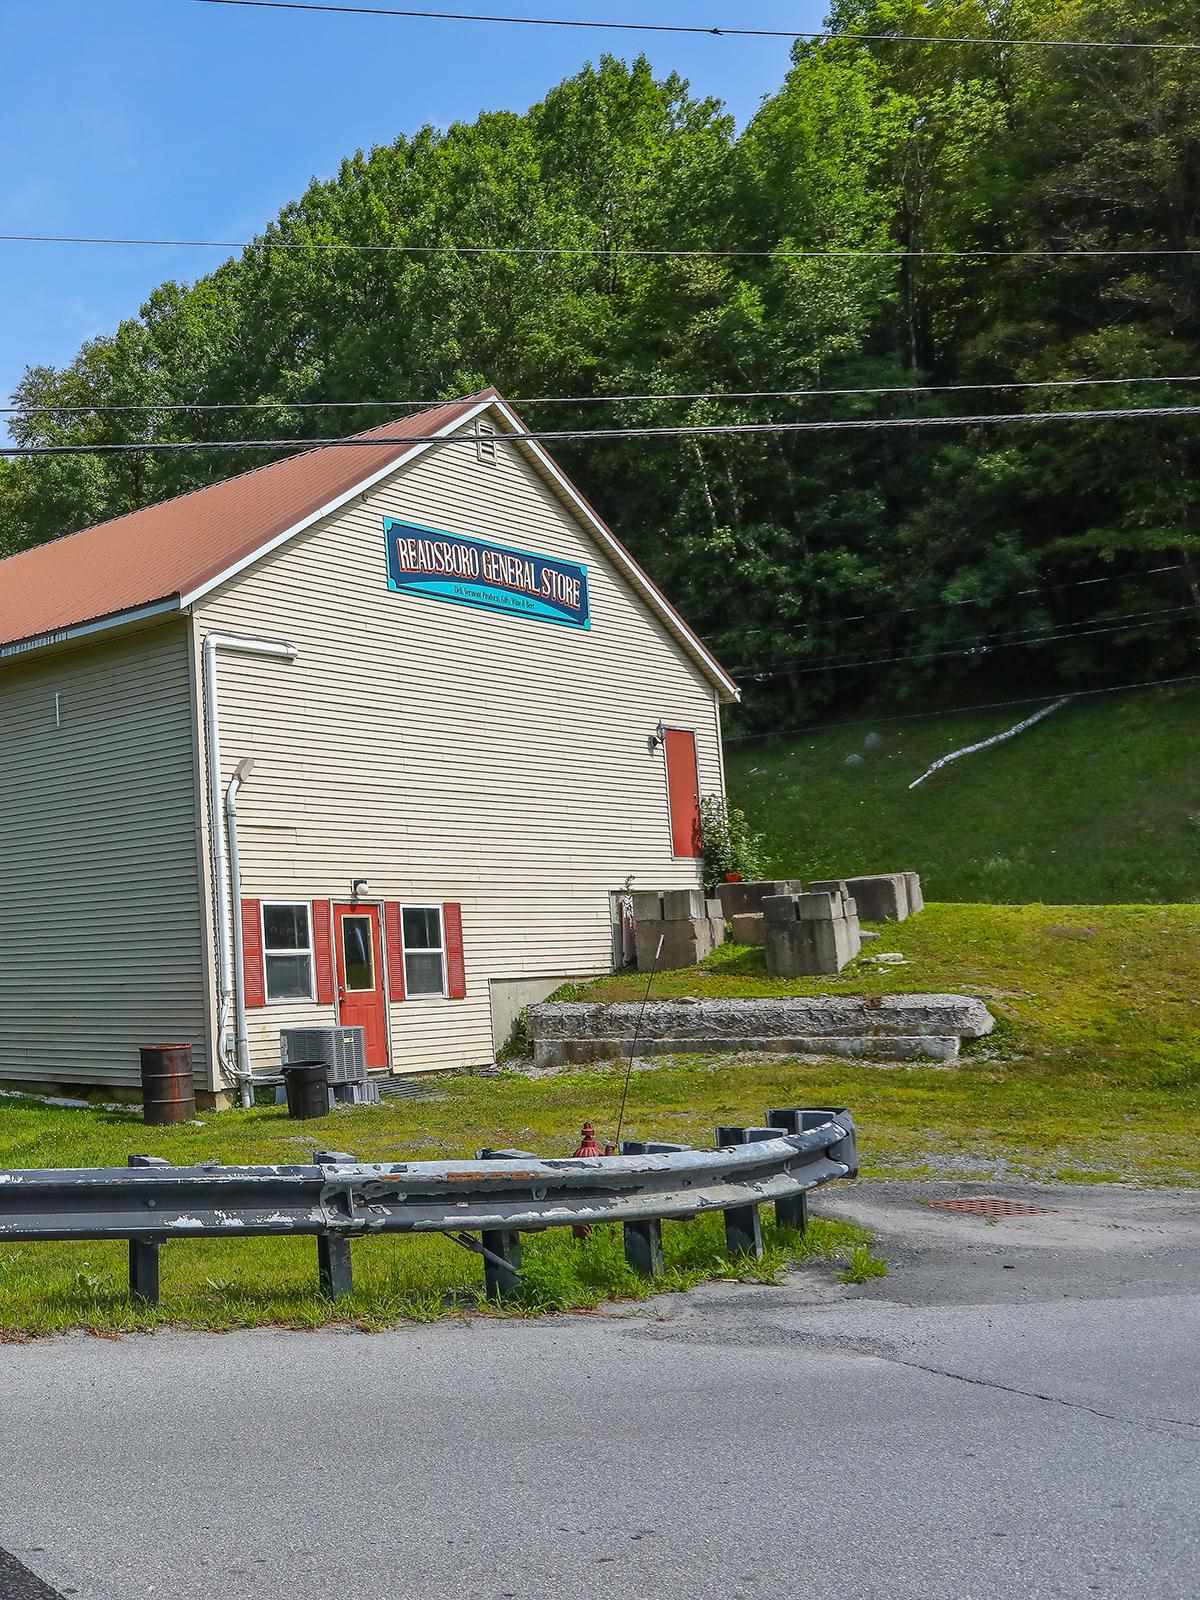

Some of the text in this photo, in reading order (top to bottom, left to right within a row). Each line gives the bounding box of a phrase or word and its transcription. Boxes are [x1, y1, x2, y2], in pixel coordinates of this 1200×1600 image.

[397, 538, 479, 578] READSBORO
[482, 551, 540, 594] GENERAL
[541, 568, 580, 608] STORE
